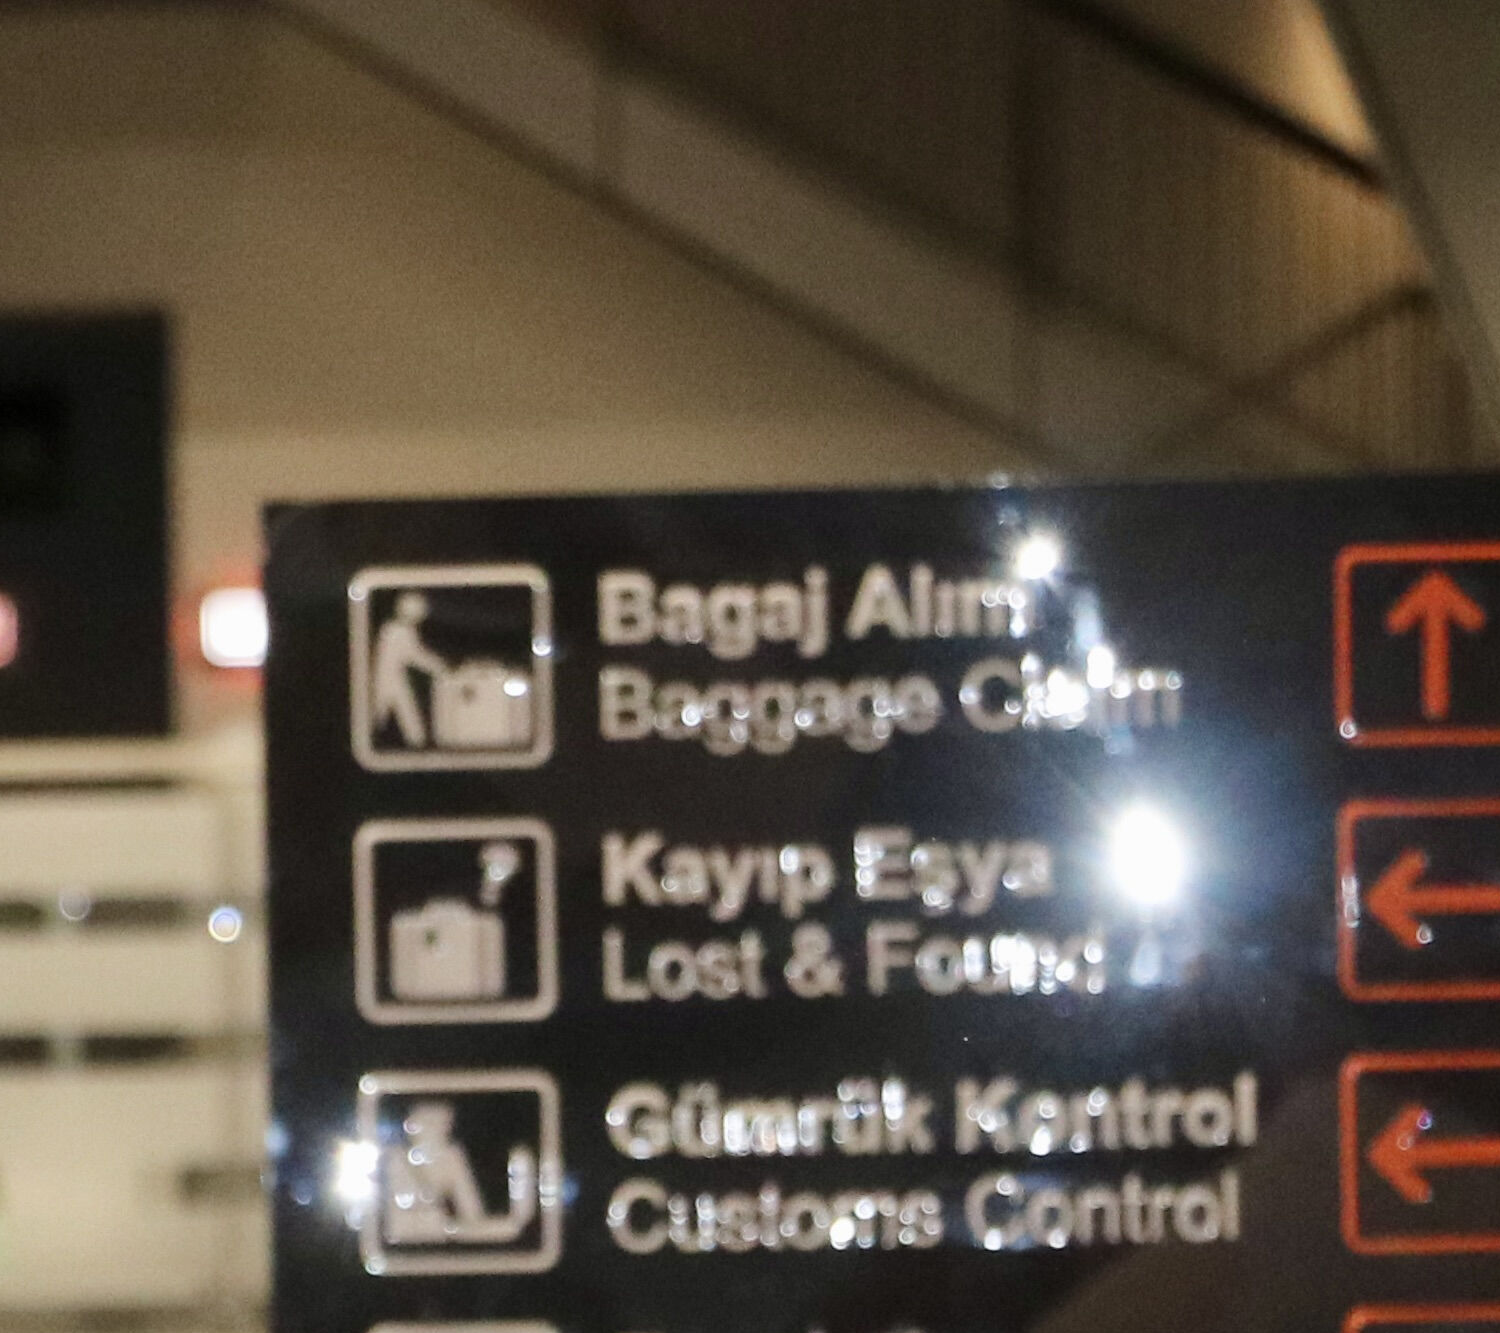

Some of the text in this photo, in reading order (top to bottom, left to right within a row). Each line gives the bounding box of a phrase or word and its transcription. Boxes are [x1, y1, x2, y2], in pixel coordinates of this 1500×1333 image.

[597, 562, 829, 661] Bagaj
[599, 652, 1184, 755] Baggage Clim
[600, 828, 835, 922] Kayıp
[602, 924, 767, 1002] Lost
[786, 919, 845, 998] &
[606, 1067, 1259, 1159] Gümrük Kontrol
[606, 1169, 1241, 1255] Customs Control
